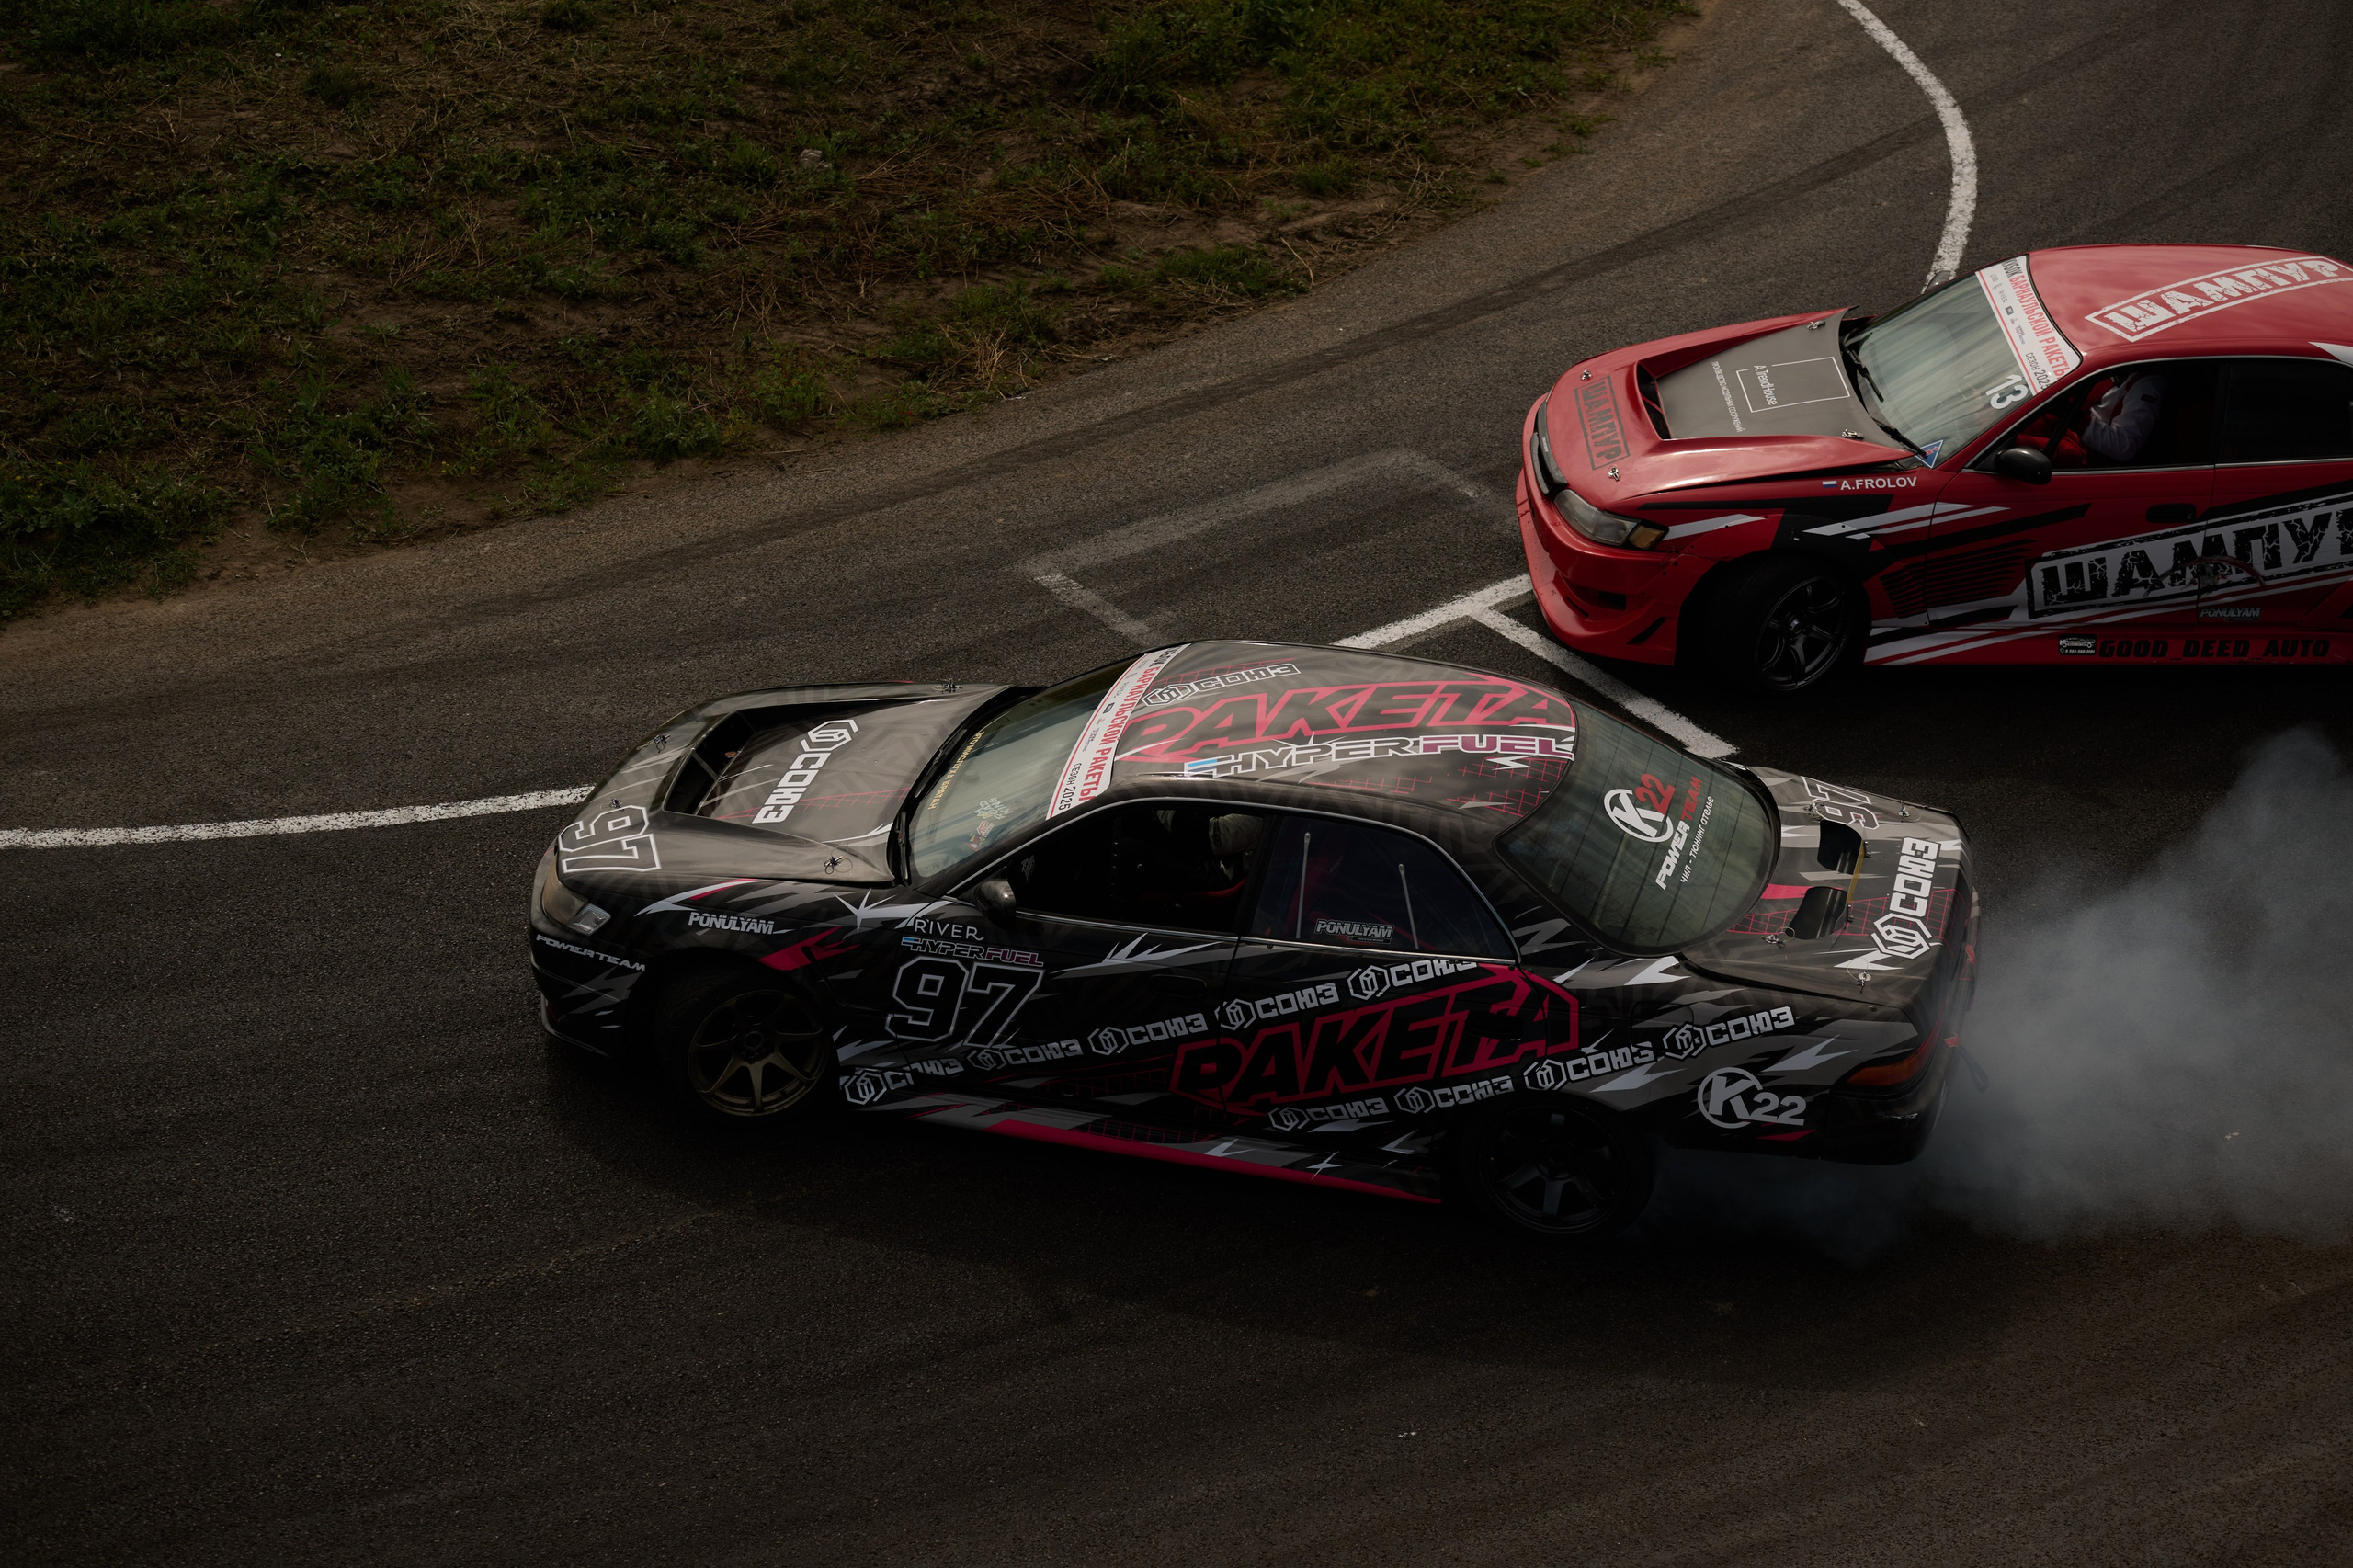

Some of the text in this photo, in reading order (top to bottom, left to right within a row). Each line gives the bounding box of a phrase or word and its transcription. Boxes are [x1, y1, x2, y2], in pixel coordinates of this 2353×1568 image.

[2009, 273, 2055, 336] БАРНАУЛЬСКОЙ
[2103, 260, 2339, 332] ШАМПУР
[1985, 374, 2029, 409] 13
[2025, 352, 2052, 391] СЕЗОН 2025
[1581, 381, 1622, 460] ШАМПУР
[1103, 666, 1161, 745] БАРНАУЛЬСКОЙ
[752, 751, 832, 824] СОЮЗ
[1059, 762, 1082, 811] СЕЗОН 2025
[1079, 746, 1111, 801] РАКЕТЫ
[1801, 776, 1879, 830] 97
[558, 805, 662, 873] 97
[1889, 836, 1941, 917] СОЮЗ
[688, 912, 775, 935] PONULYAM
[914, 919, 985, 941] RIVER
[1315, 919, 1393, 938] PONULYAM
[884, 955, 1046, 1048] 97
[1254, 983, 1339, 1019] СОЮЗ
[1126, 1013, 1209, 1046] СОЮЗ
[1704, 1006, 1796, 1046] СОЮЗ
[1006, 1038, 1084, 1065] СОЮЗ
[1566, 1040, 1657, 1082] СОЮЗ
